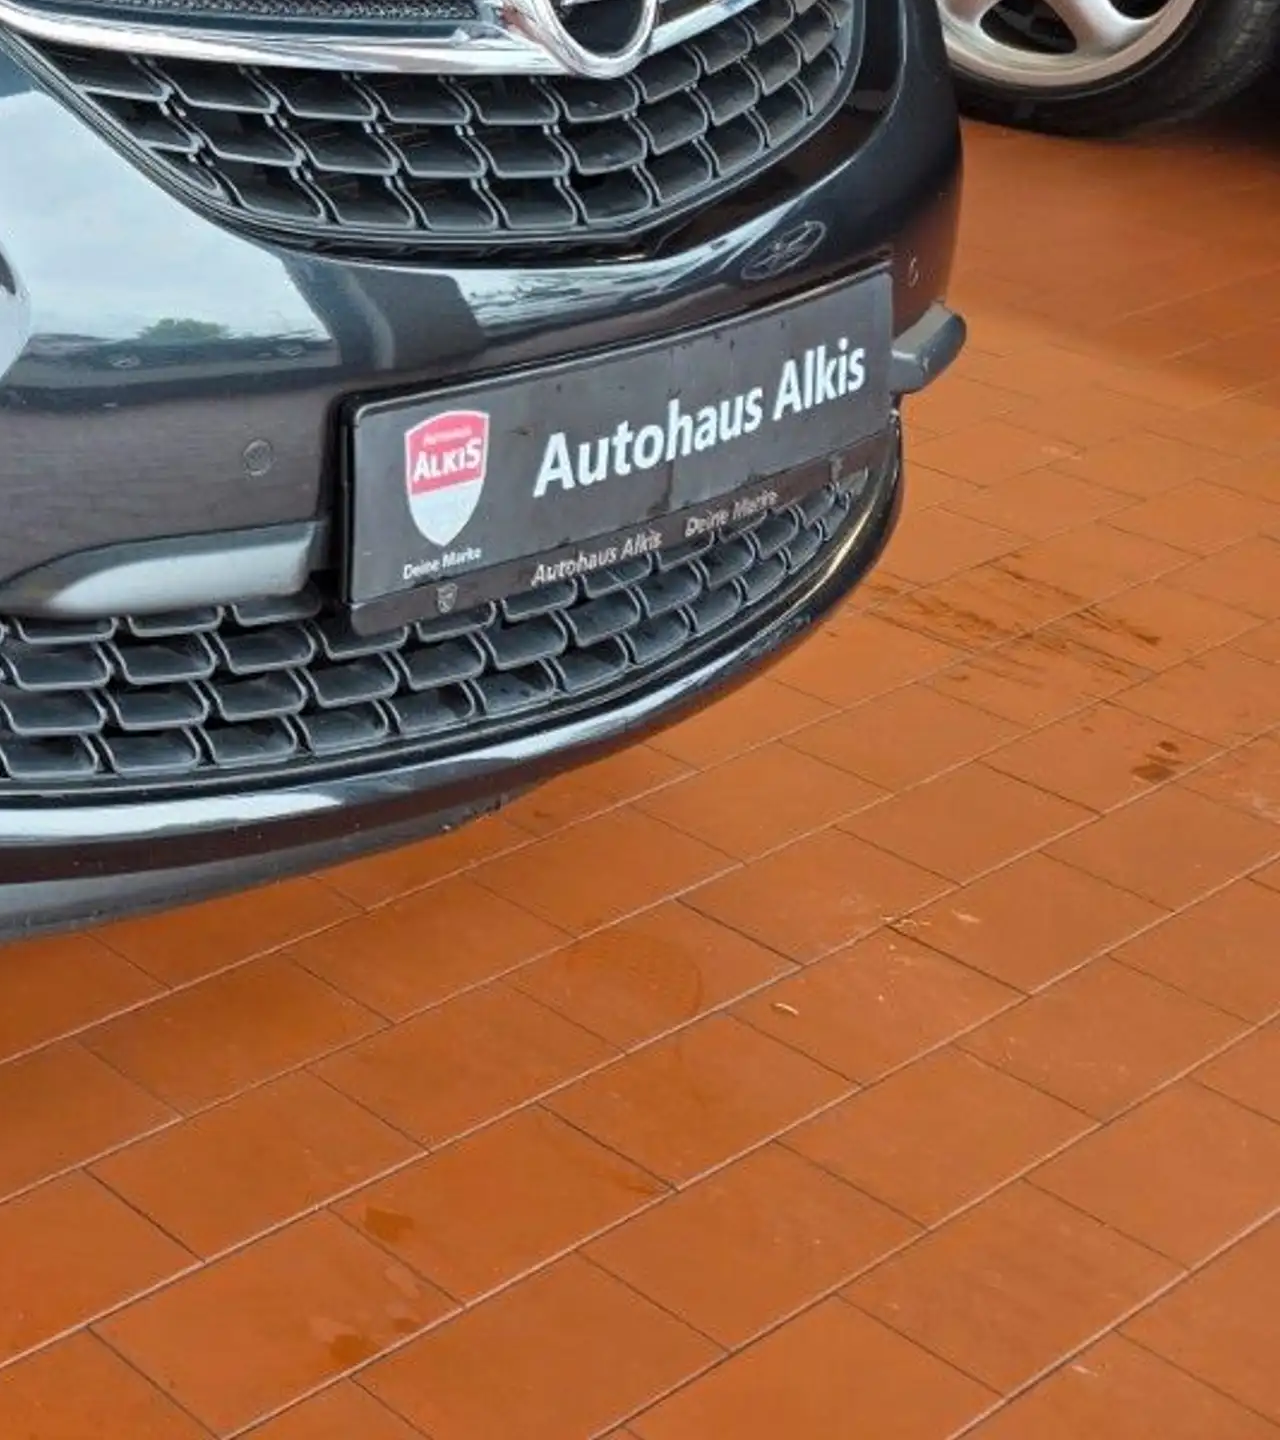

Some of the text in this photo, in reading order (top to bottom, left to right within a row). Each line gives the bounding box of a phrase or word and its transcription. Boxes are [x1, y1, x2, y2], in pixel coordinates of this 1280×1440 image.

[532, 337, 866, 498] Autohaus Alkis
[413, 437, 482, 483] ALKIS
[403, 546, 482, 580] Deine Marke
[530, 546, 618, 586] Autohaus
[620, 526, 663, 560] Alkis
[684, 508, 729, 538] Deine
